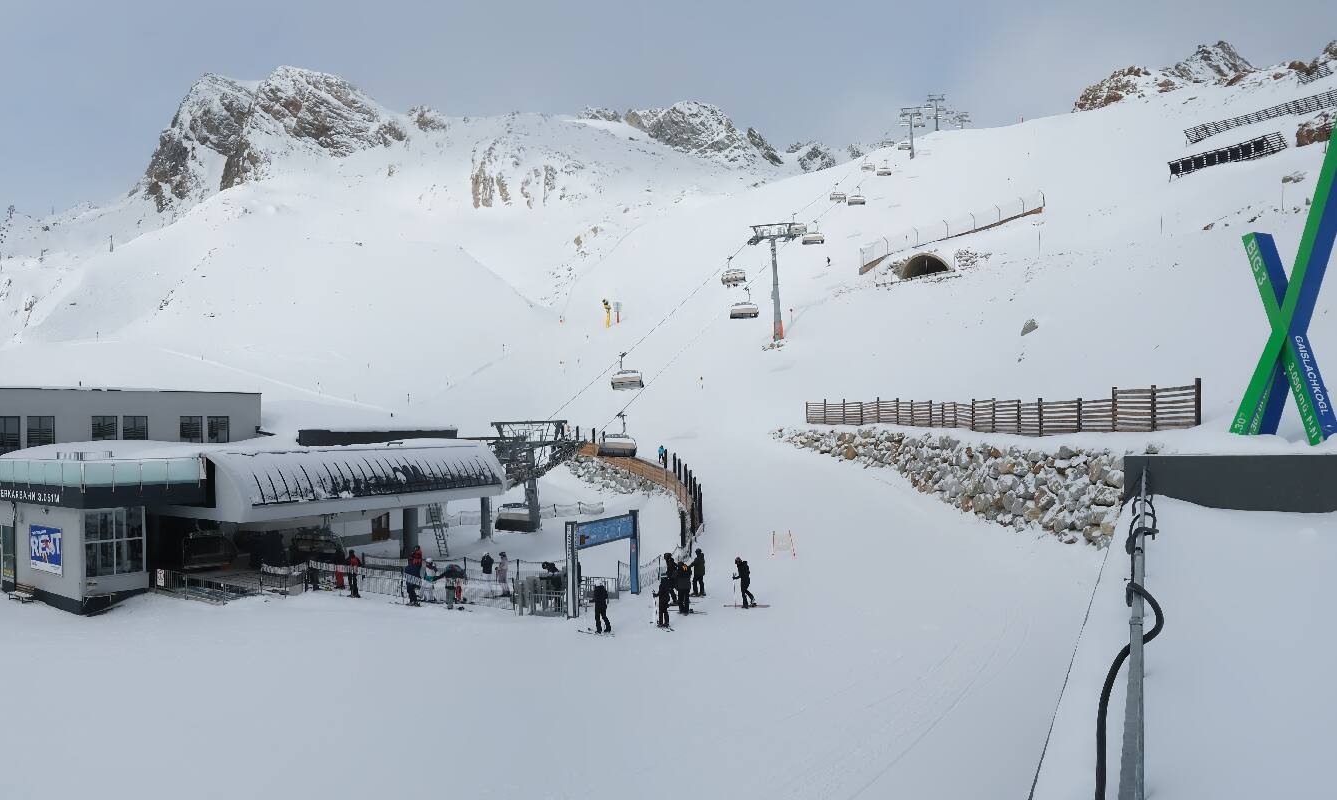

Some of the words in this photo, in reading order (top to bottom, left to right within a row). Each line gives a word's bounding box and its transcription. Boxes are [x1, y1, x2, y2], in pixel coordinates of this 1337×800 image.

[1247, 239, 1261, 272] BIG
[1258, 272, 1266, 286] 3
[1294, 335, 1328, 416] GAISLACHKOGL
